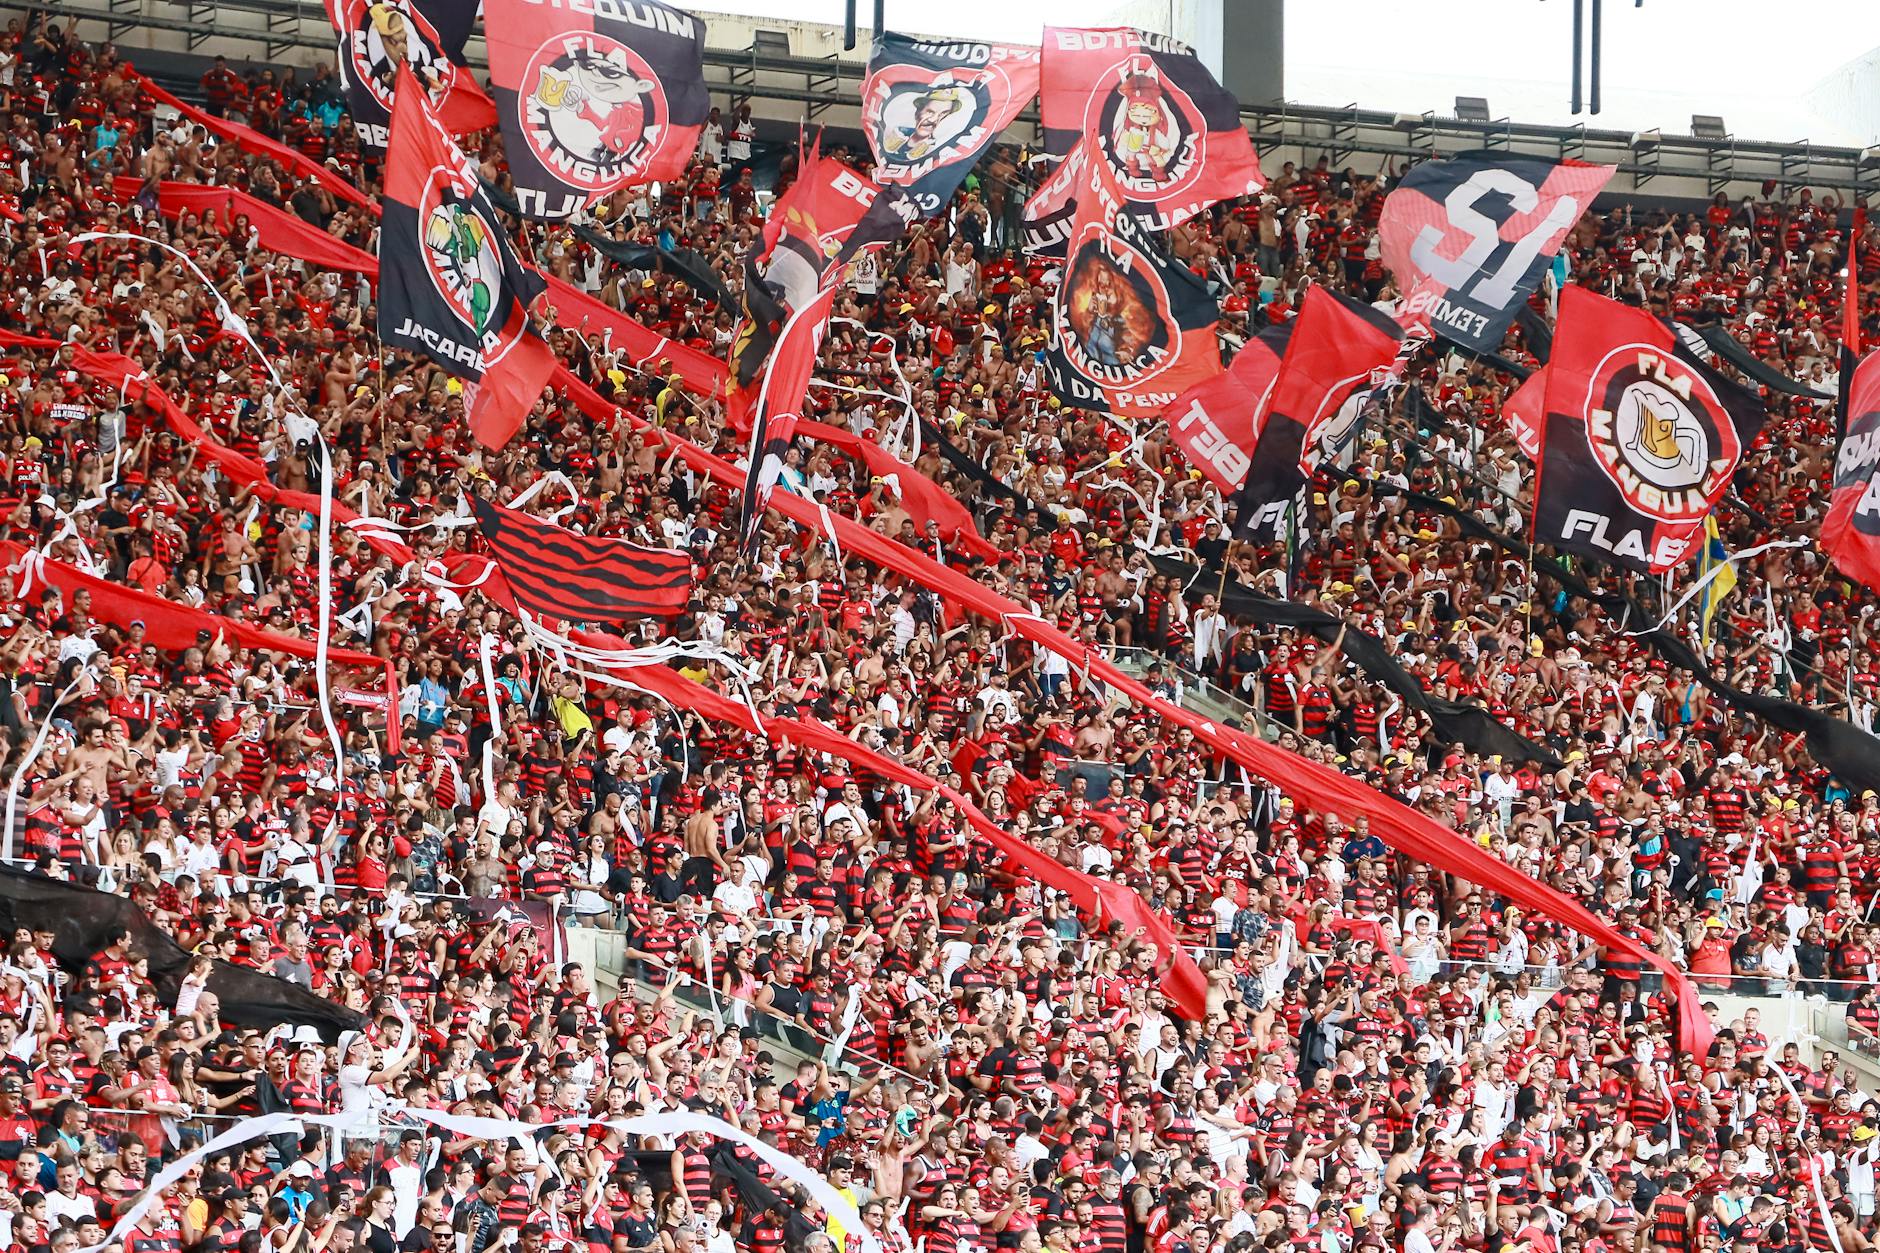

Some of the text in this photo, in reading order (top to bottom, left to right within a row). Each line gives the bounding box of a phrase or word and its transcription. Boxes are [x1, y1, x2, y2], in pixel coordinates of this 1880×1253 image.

[562, 36, 628, 72] FLA
[1117, 58, 1159, 84] FLA
[1100, 231, 1134, 275] FLA
[1071, 377, 1110, 405] DA
[1637, 352, 1693, 401] FLA
